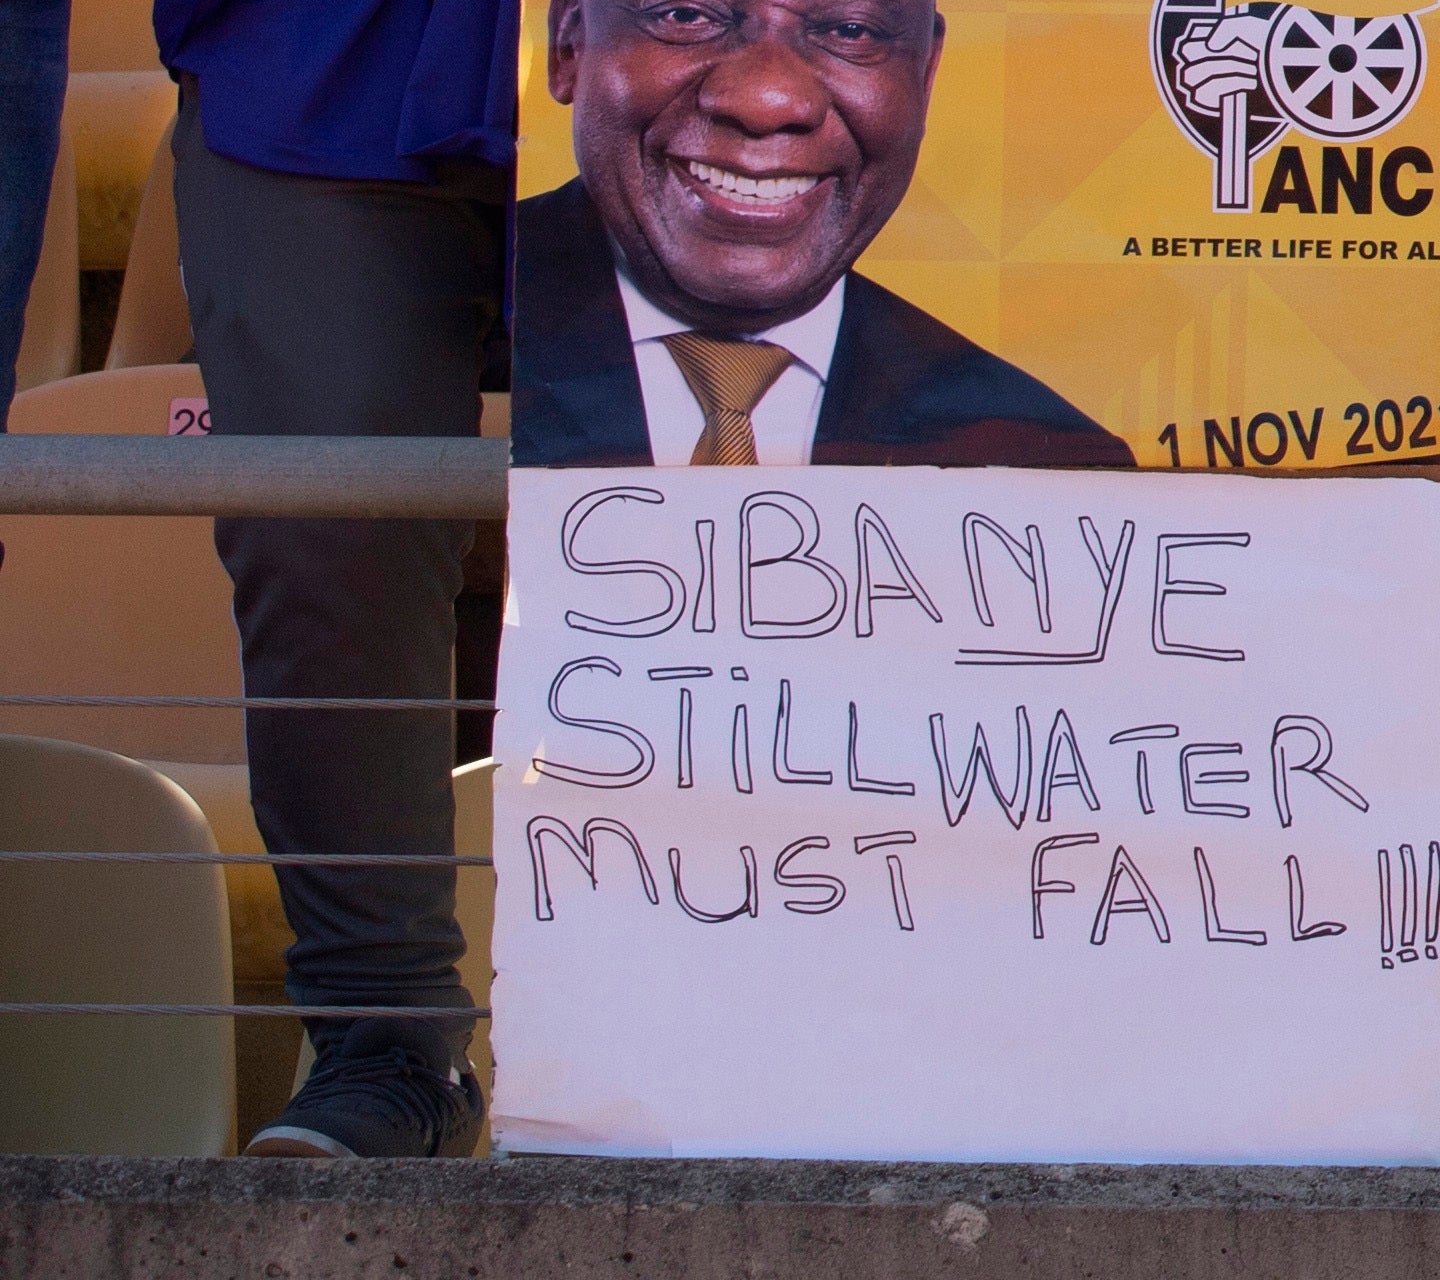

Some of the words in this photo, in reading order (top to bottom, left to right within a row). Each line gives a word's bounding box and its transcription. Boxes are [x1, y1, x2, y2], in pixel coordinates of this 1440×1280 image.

[1260, 144, 1434, 217] ANC
[1122, 237, 1142, 257] A
[1152, 237, 1262, 258] BETTER
[1271, 239, 1332, 259] LIFE
[1342, 240, 1398, 261] FOR
[1158, 423, 1179, 467] 1
[1205, 407, 1324, 467] NOV
[562, 486, 1250, 664] SIBANYE
[527, 816, 916, 931] MUST
